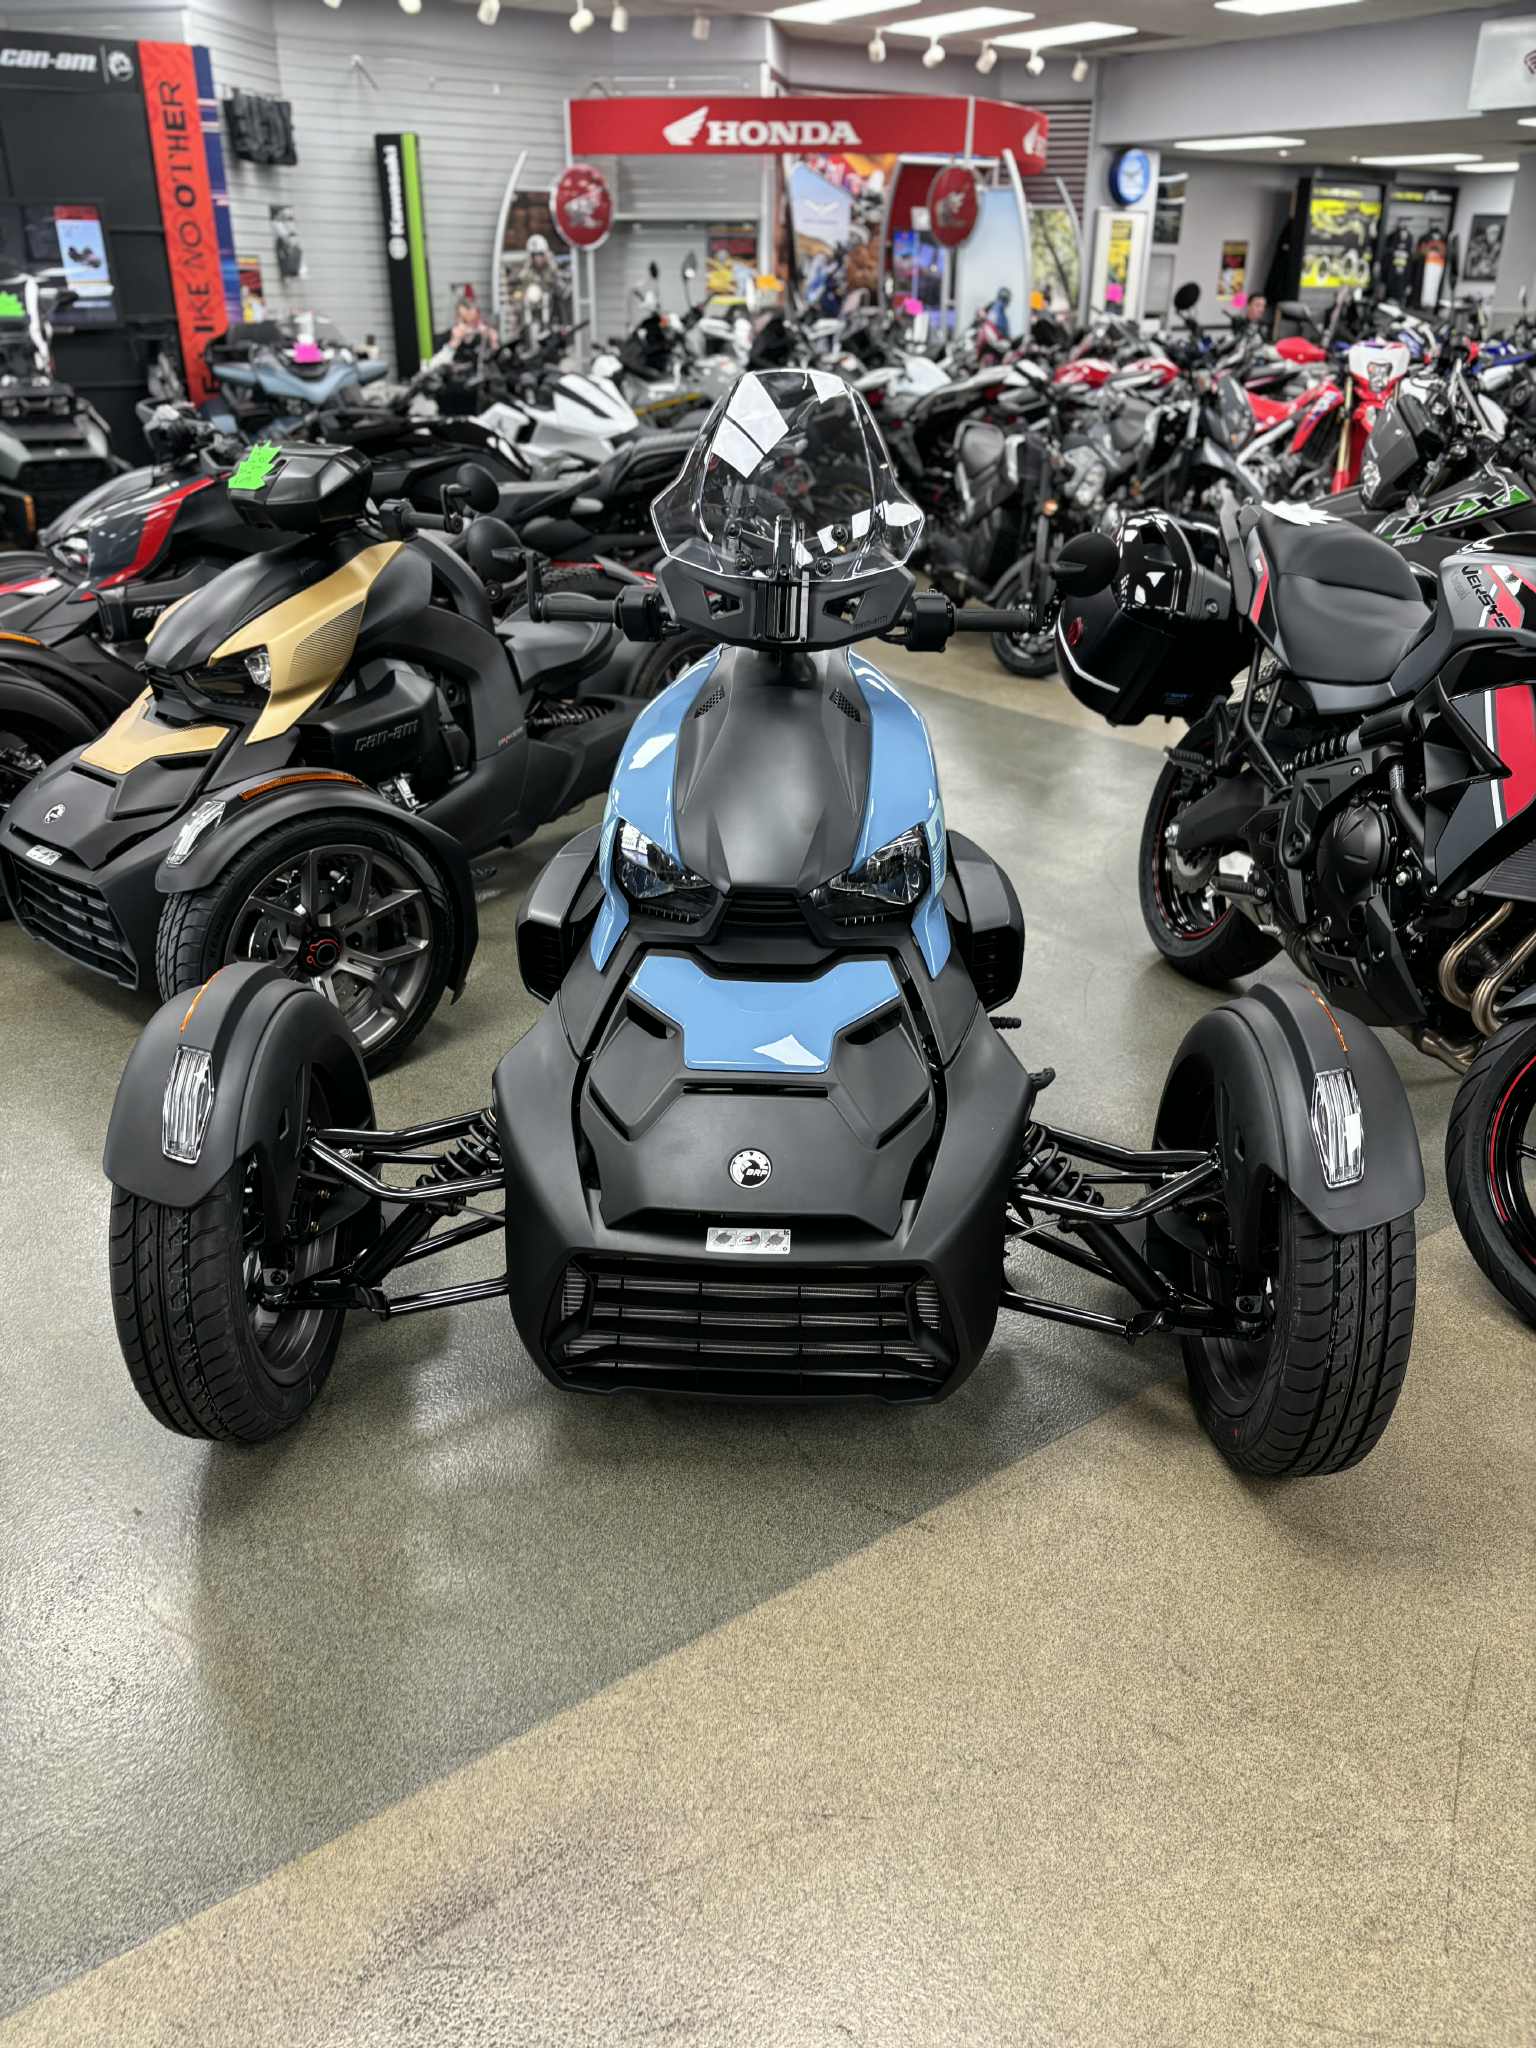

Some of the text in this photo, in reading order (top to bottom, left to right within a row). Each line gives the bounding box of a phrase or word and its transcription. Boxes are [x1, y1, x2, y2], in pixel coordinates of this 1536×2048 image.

[0, 48, 98, 72] can-am
[159, 79, 197, 209] OTHER
[706, 120, 862, 146] HONDA
[179, 220, 206, 271] NO
[131, 604, 167, 620] can
[745, 1168, 769, 1177] BRP
